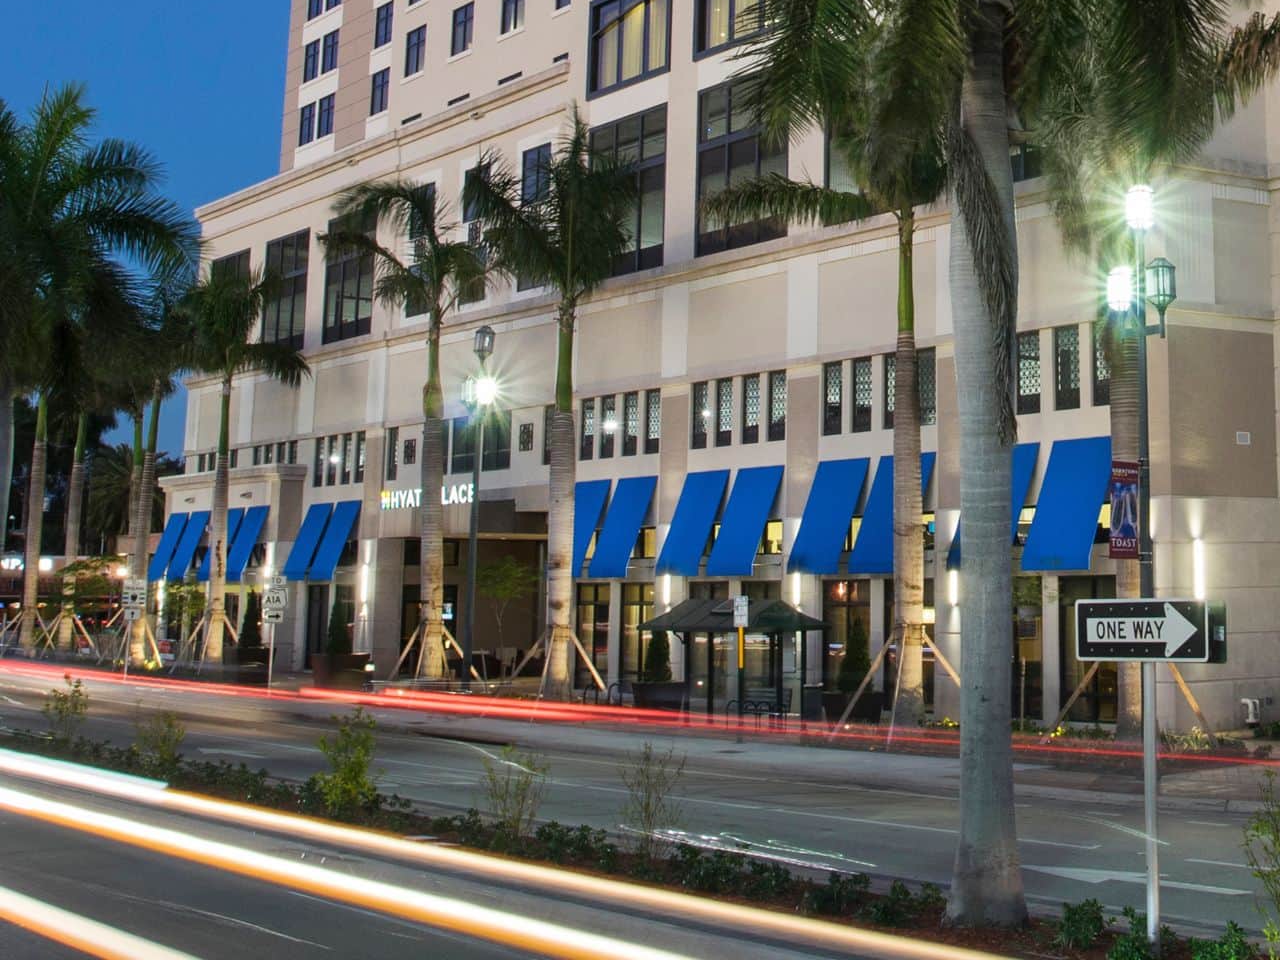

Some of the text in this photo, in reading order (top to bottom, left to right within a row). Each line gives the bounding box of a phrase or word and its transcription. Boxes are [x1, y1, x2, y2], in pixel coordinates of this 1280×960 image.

[391, 483, 474, 509] HYAT LACE
[1111, 538, 1136, 548] TOAST
[1096, 620, 1165, 640] ONE WAY
